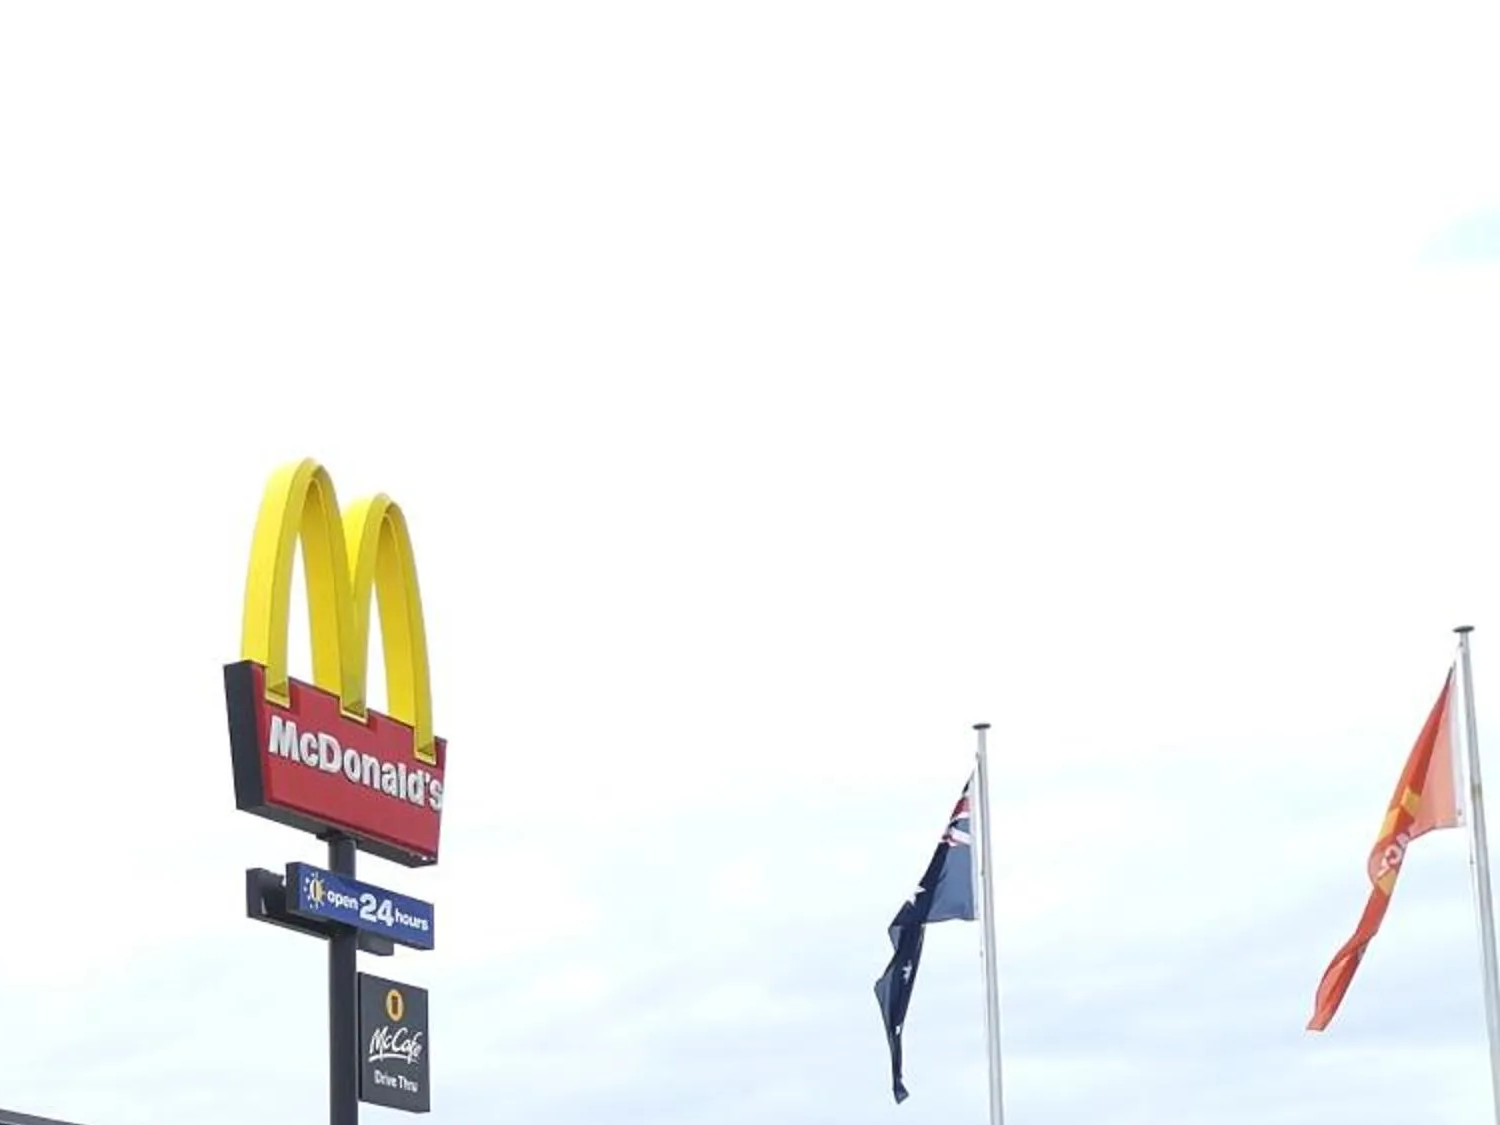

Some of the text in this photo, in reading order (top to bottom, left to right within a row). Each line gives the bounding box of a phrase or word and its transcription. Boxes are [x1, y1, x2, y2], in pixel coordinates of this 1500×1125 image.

[269, 715, 443, 811] McDonald's
[327, 890, 429, 931] open 24 hours
[374, 1069, 418, 1092] Drive Thru
